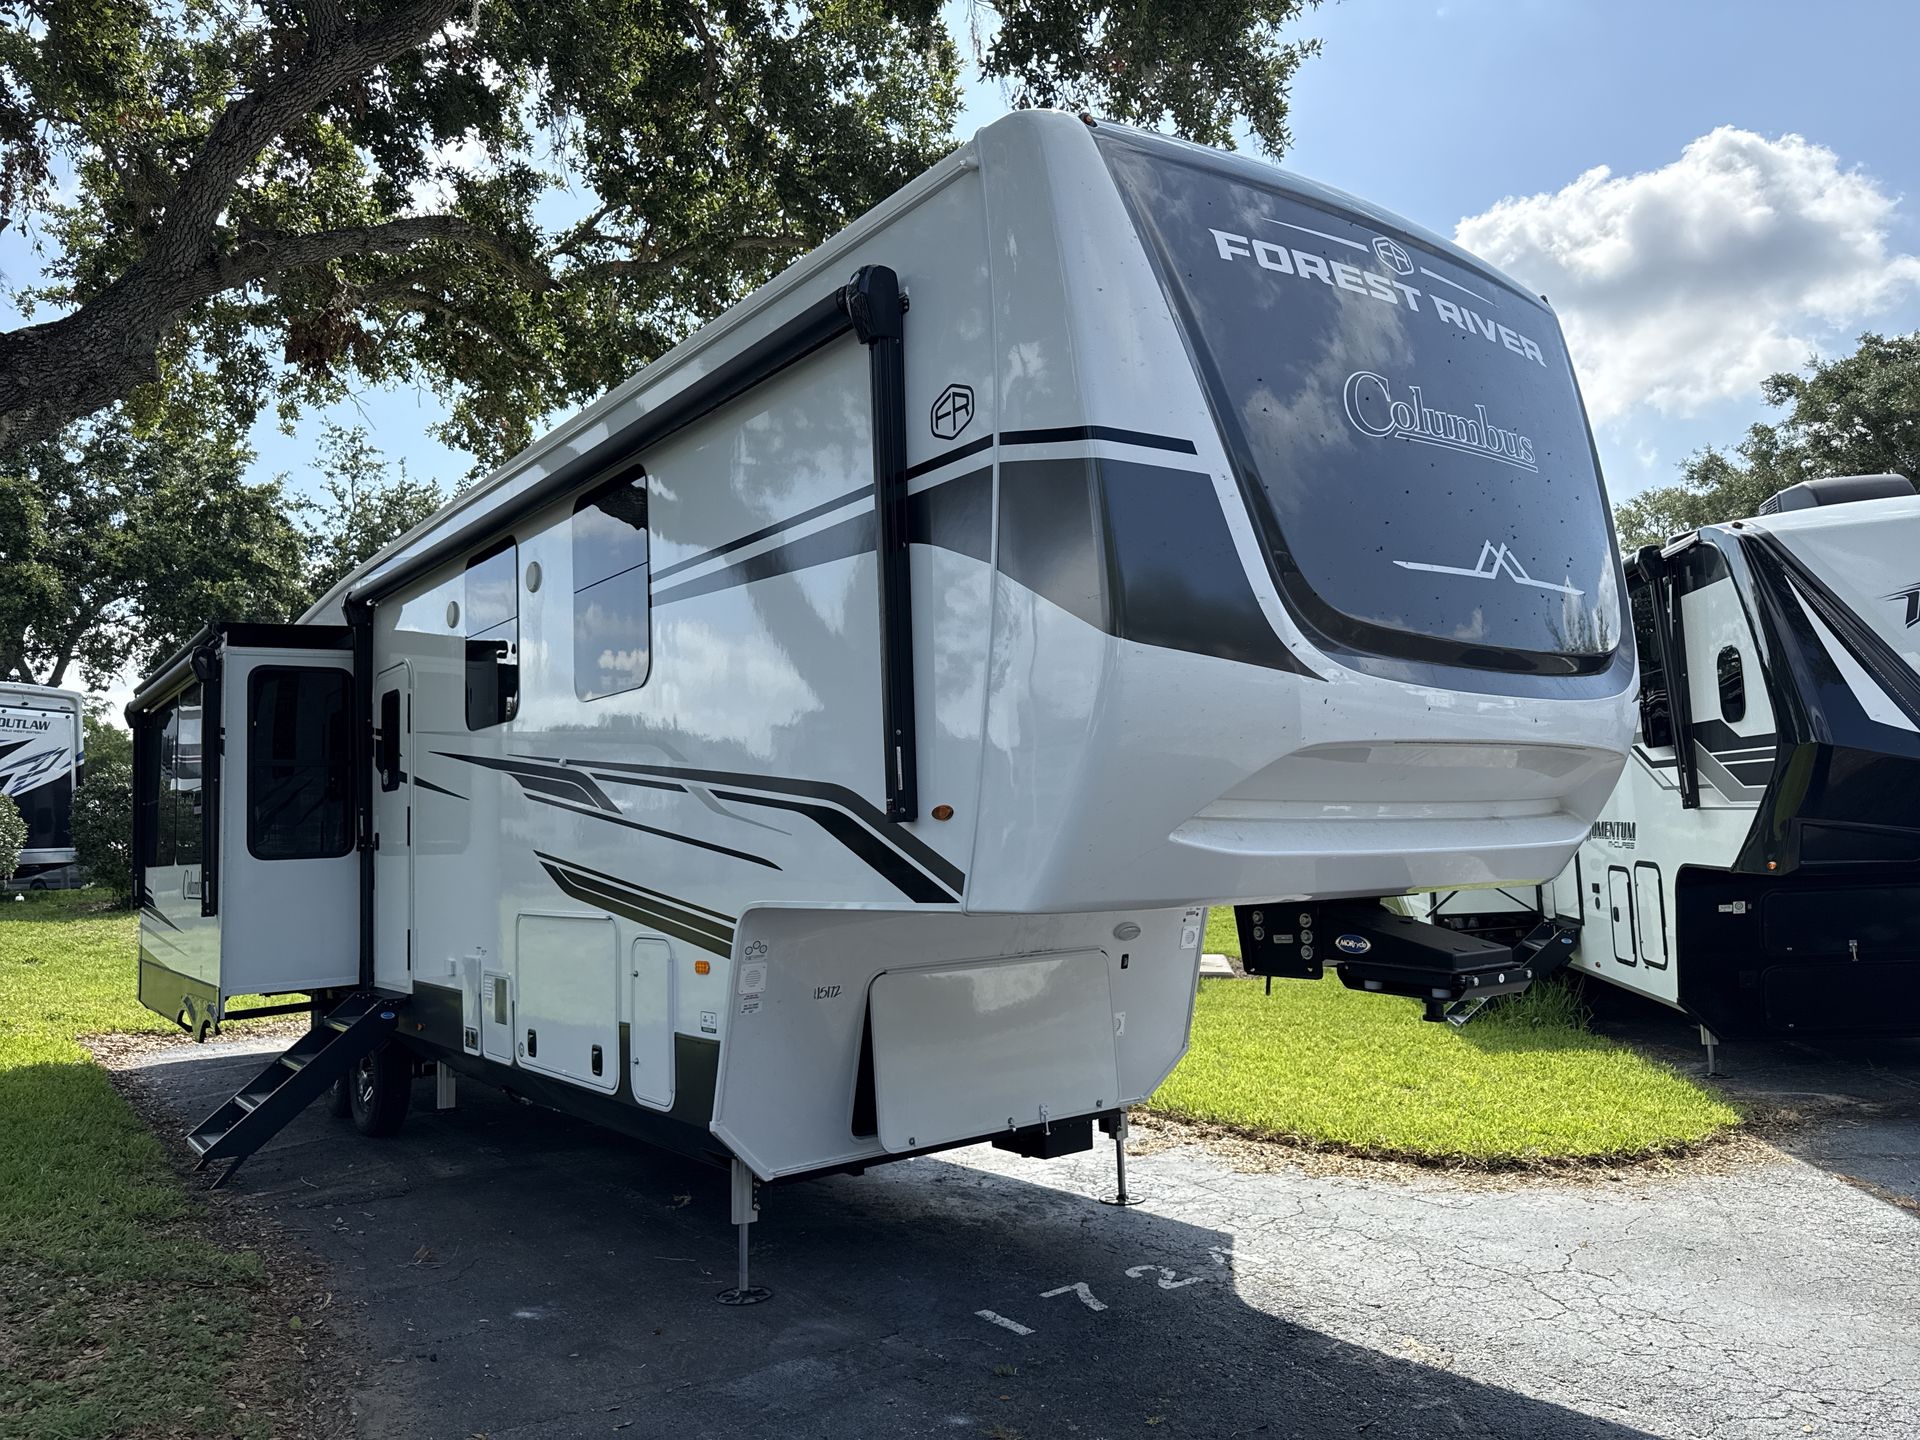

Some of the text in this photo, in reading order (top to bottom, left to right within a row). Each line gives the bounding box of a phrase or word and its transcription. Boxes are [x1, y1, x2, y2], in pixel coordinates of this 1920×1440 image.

[1208, 228, 1547, 368] FOREST RIVER
[1343, 371, 1536, 464] Columbus
